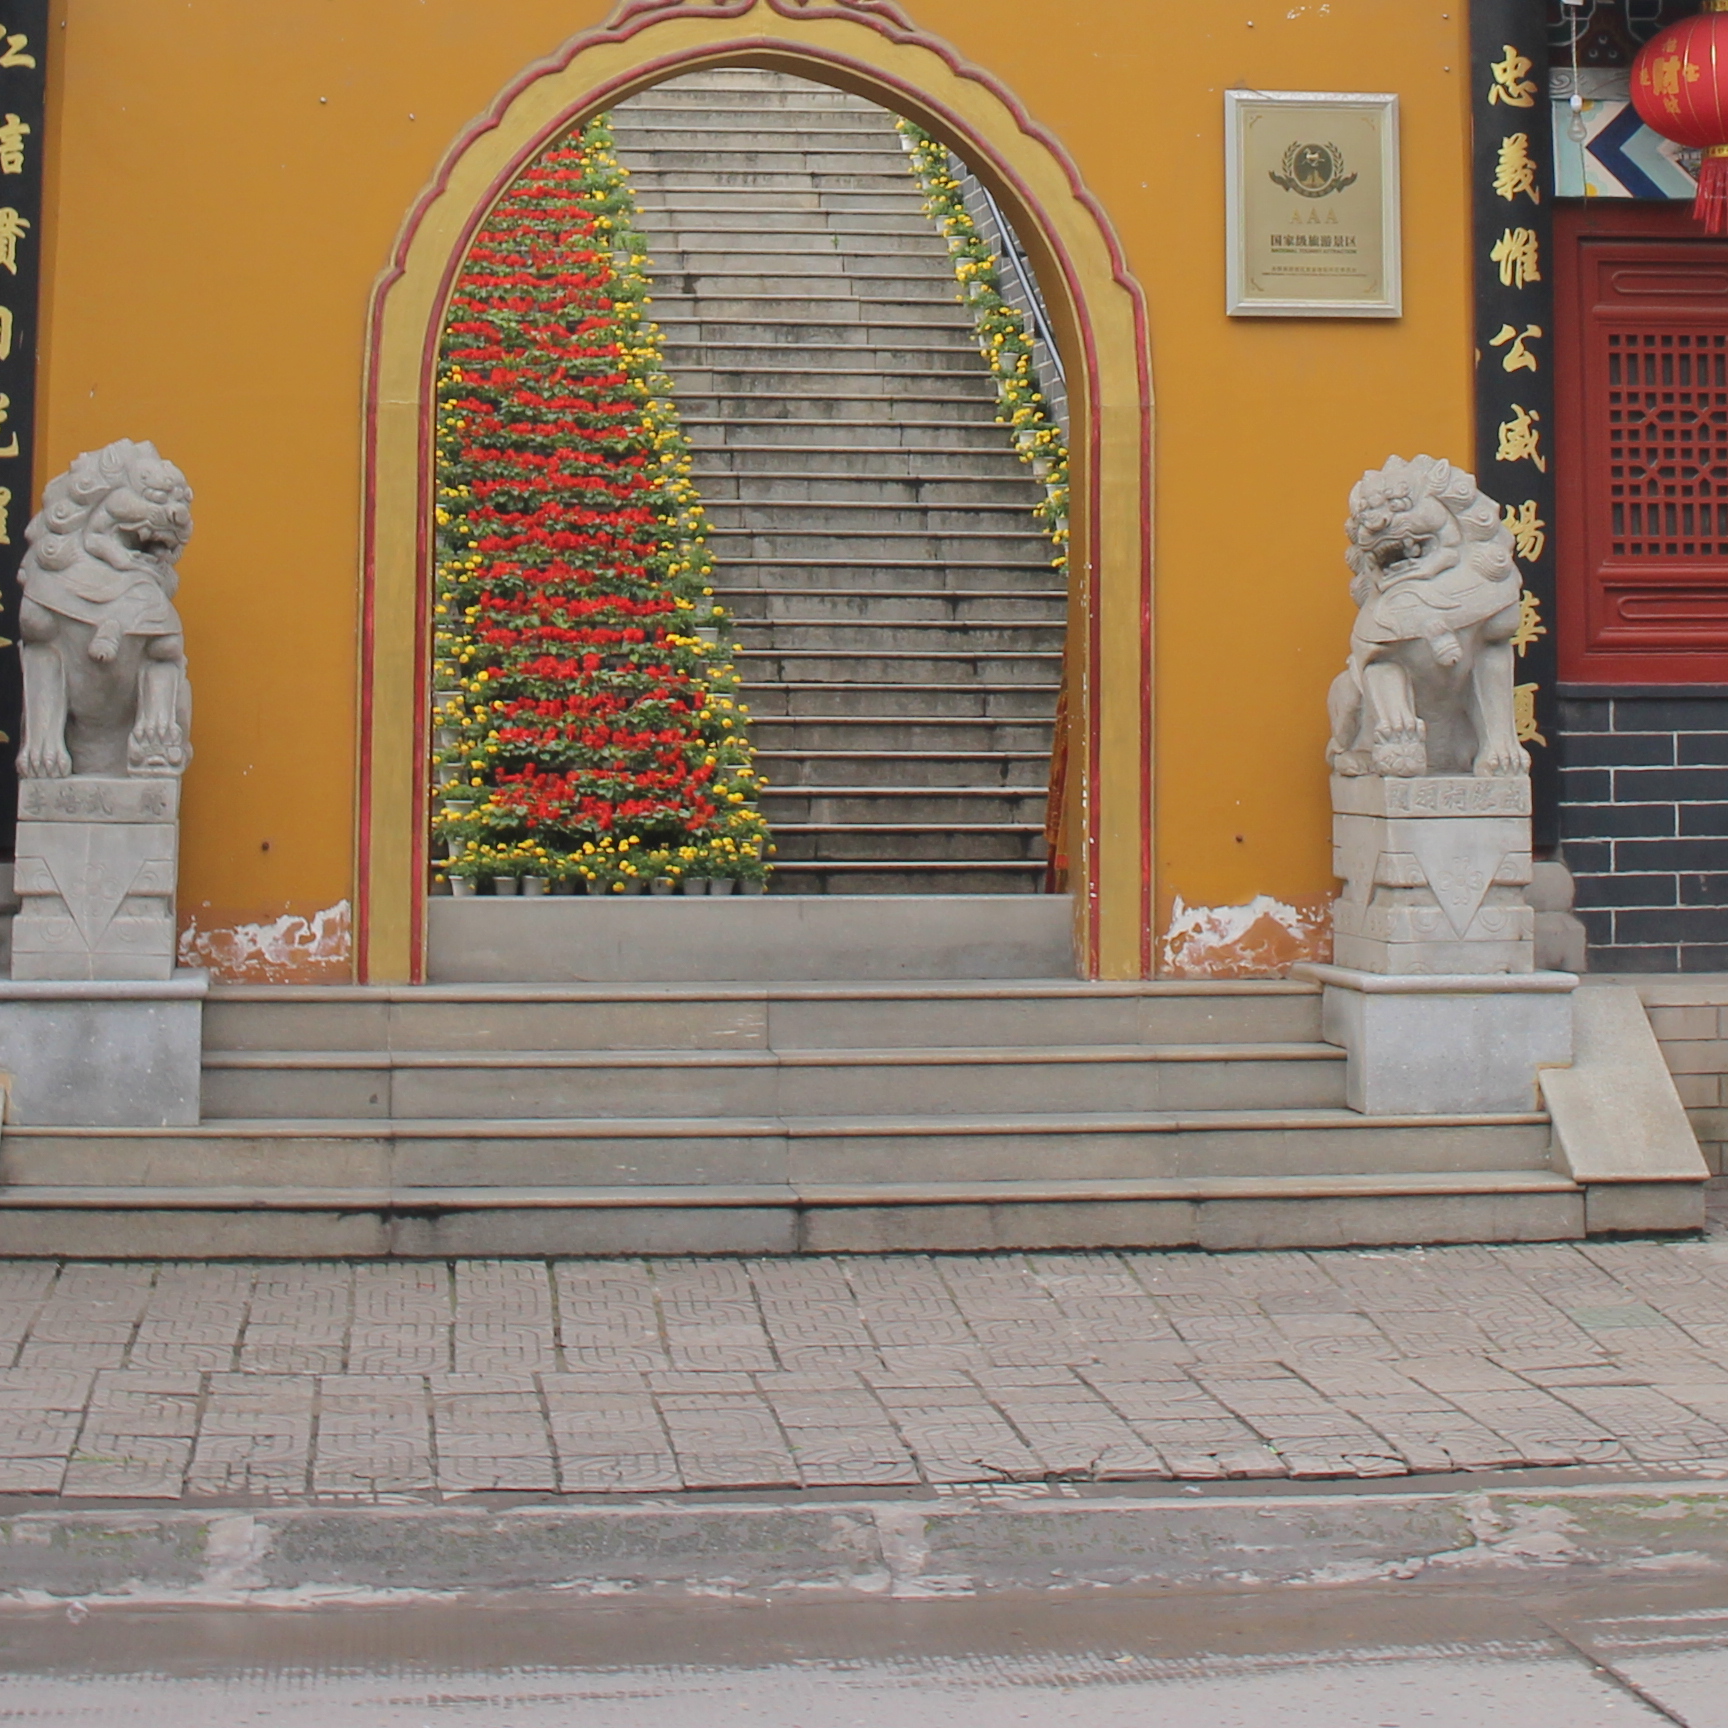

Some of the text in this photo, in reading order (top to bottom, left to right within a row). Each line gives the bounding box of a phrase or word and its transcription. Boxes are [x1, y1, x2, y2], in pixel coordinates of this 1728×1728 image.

[1271, 235, 1356, 247] 国家级旅游景区
